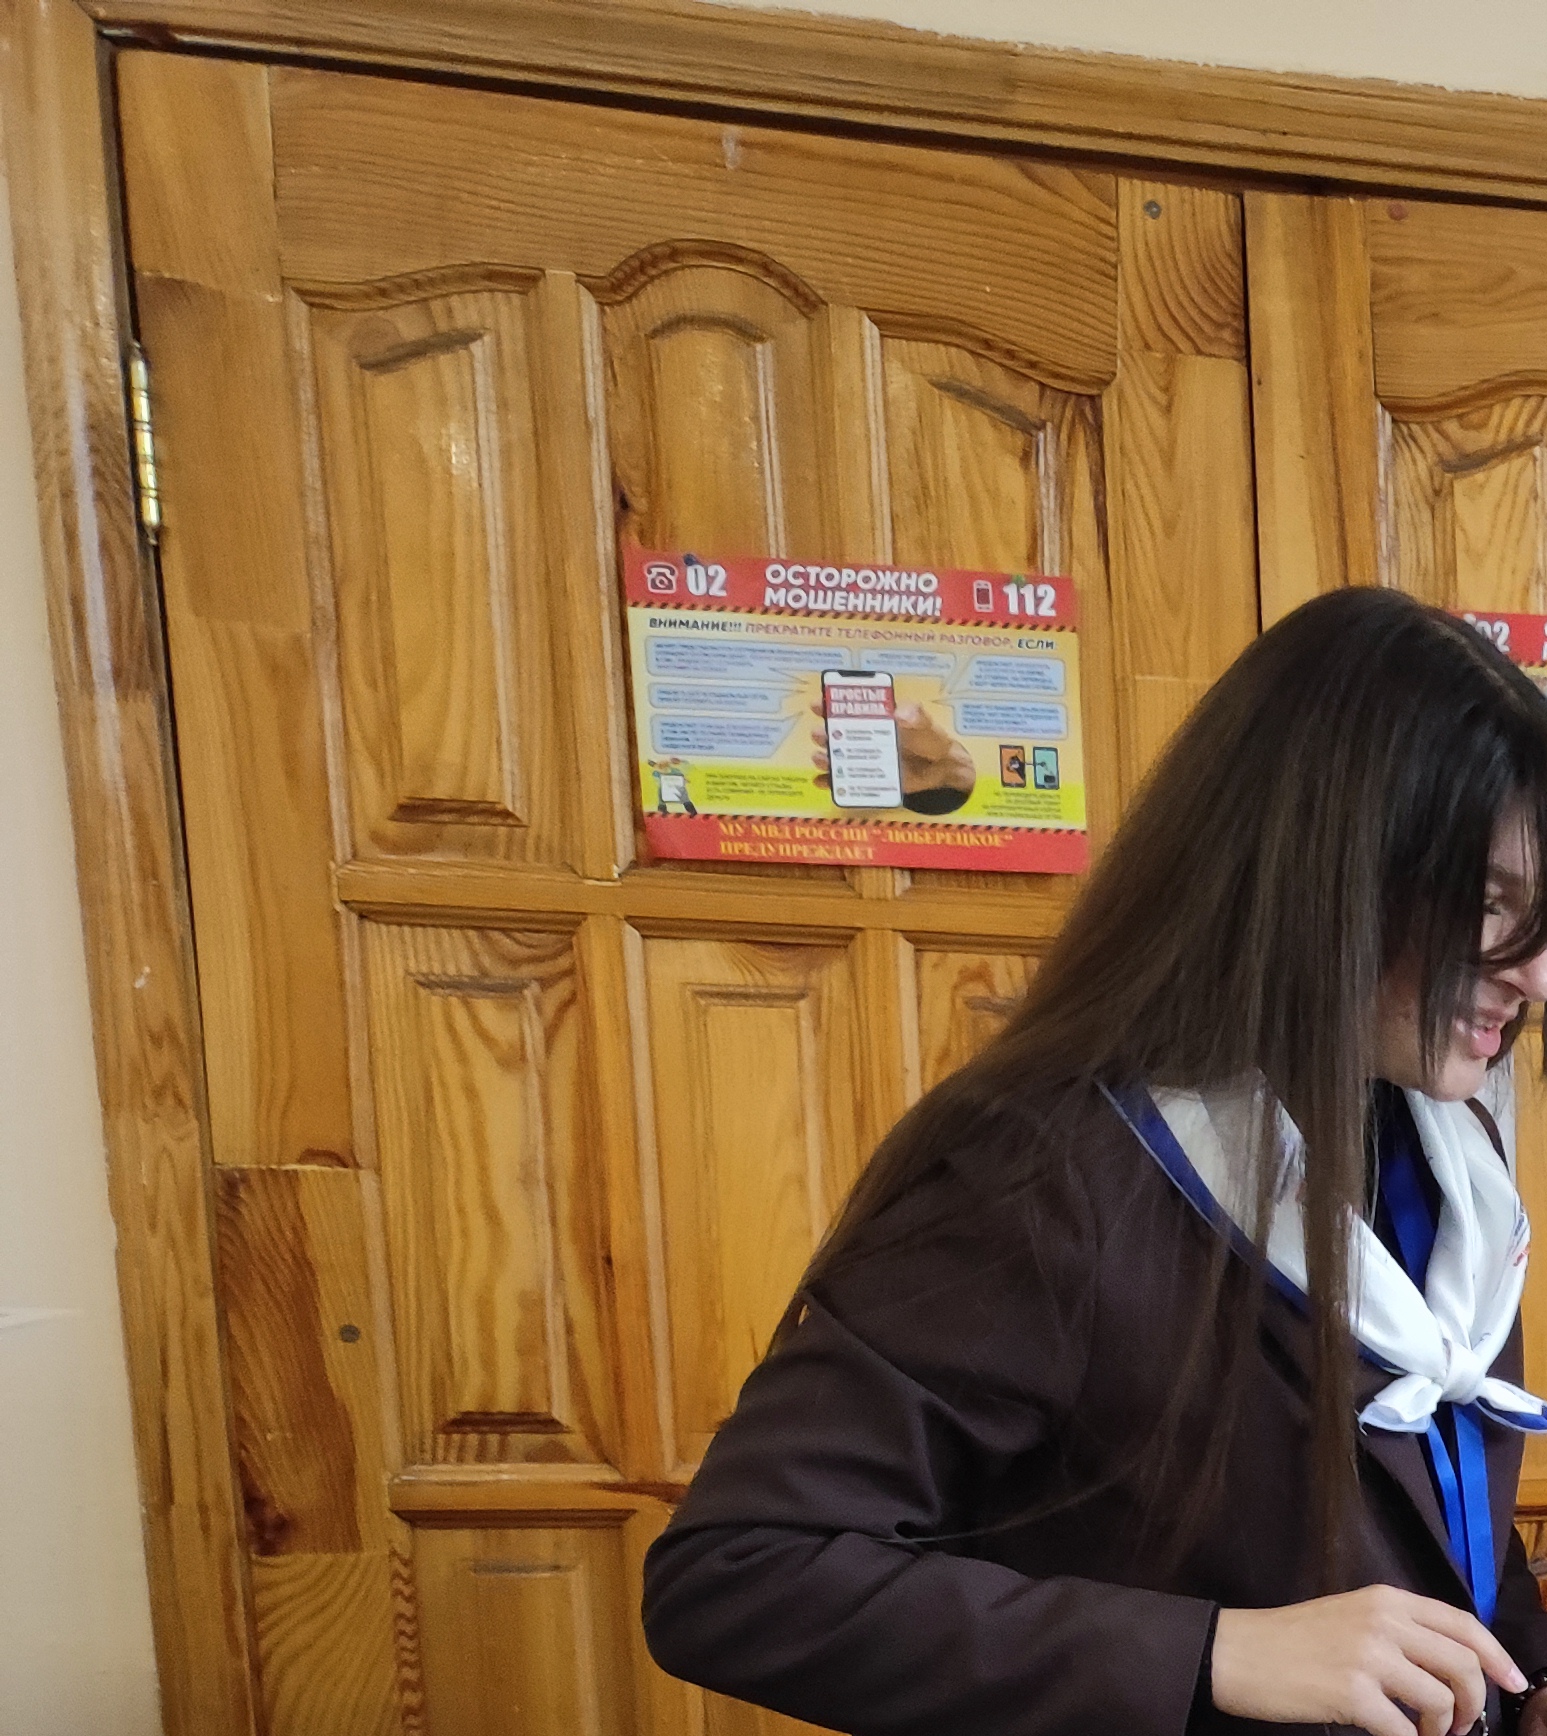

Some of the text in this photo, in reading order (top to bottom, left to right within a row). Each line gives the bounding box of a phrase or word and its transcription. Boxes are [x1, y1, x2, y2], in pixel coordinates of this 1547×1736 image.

[686, 563, 727, 598] 02
[765, 562, 939, 594] ОСТОРОЖНО
[764, 586, 942, 618] МОШЕННИКИ!
[1003, 582, 1057, 617] 112
[649, 617, 742, 634] ВНИМАНИЕ!!!
[745, 623, 833, 638] ПРЕКРАТИТЕ
[837, 627, 936, 644] ТЕЛЕФОННЫЙ
[829, 684, 887, 702] ПРОСТЫЕ
[830, 701, 887, 717] ПРАВИЛА
[795, 826, 868, 842] РОССИИ
[720, 841, 874, 861] ПРЕДУПРЕЖДАЕТ
